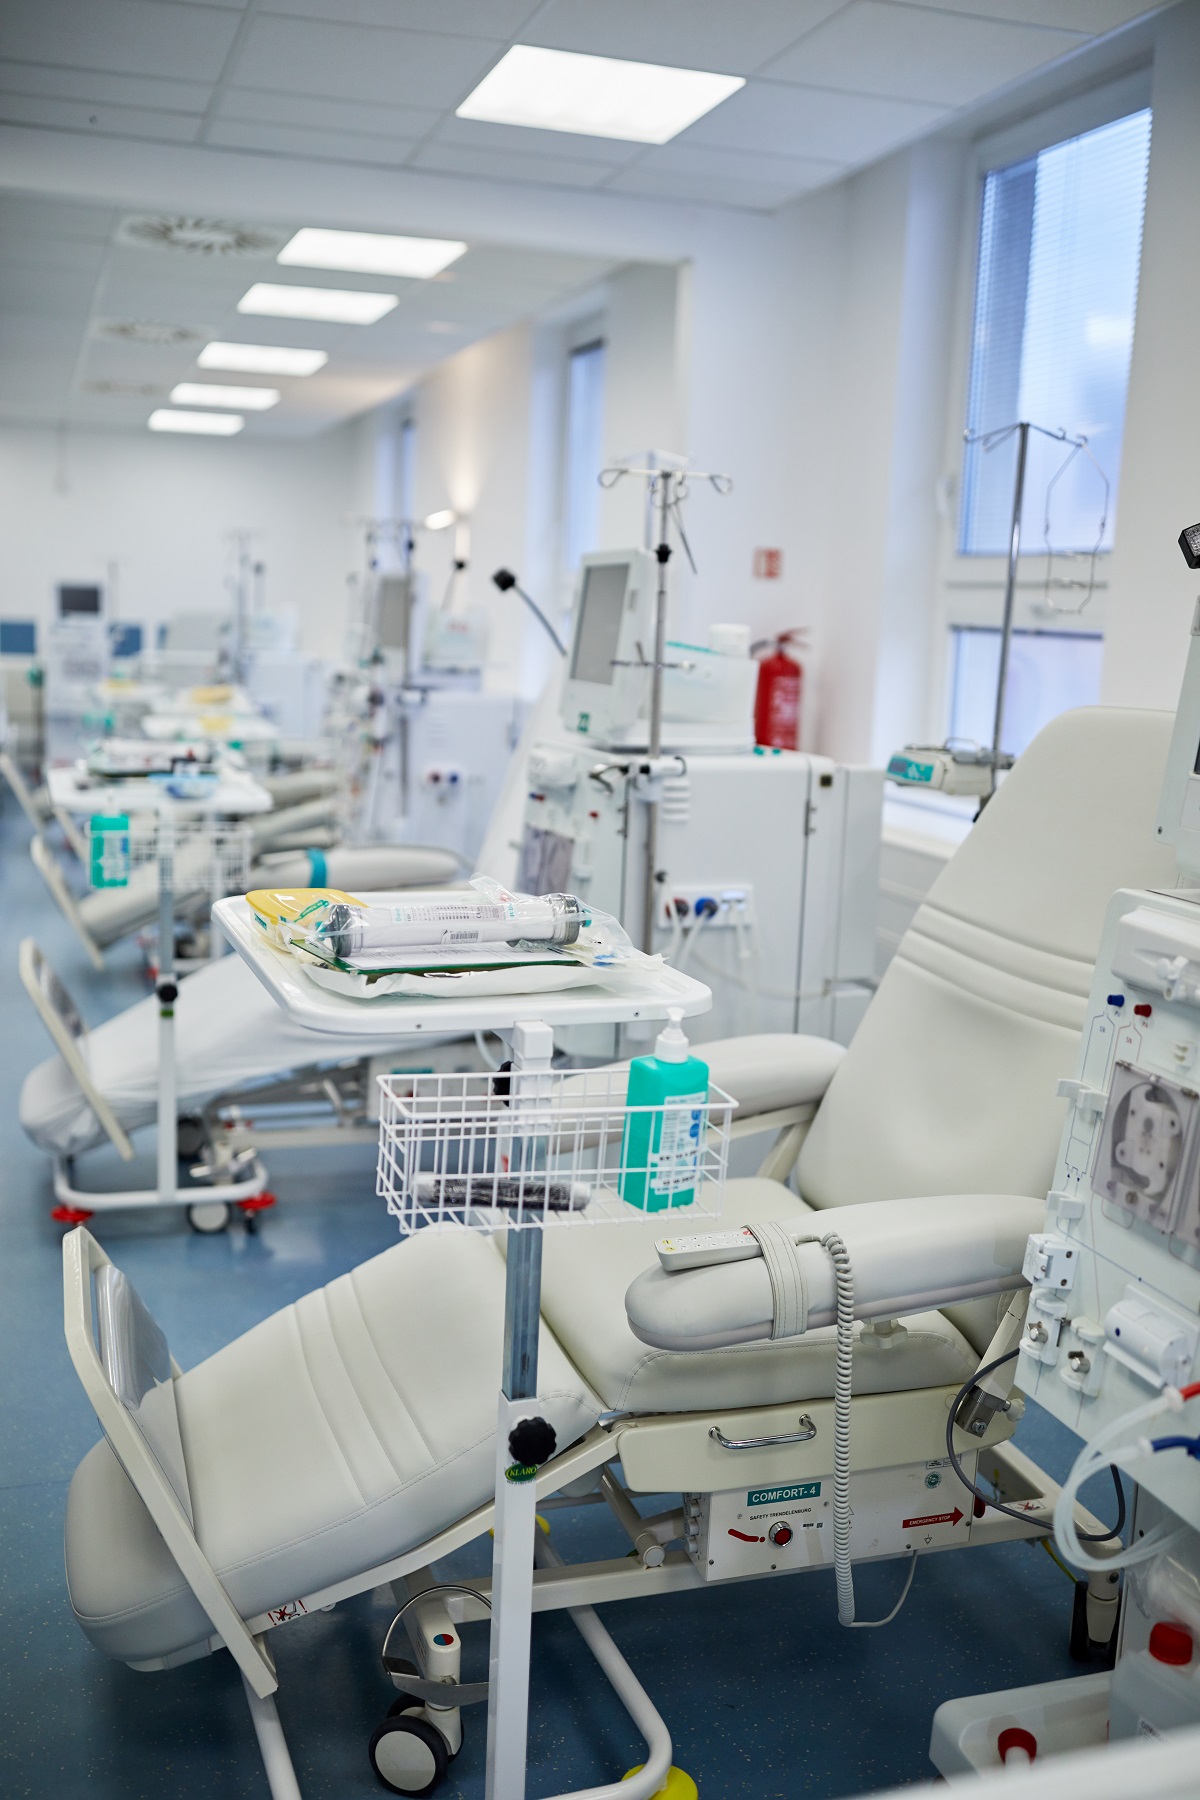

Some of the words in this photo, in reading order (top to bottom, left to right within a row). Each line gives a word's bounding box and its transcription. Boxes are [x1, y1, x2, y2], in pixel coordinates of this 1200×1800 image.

[809, 1485, 816, 1495] 4
[749, 1512, 768, 1521] SAFETY
[769, 1507, 812, 1519] TRENDELENBURG
[909, 1516, 938, 1526] EMERGENCY
[938, 1514, 951, 1522] STOP
